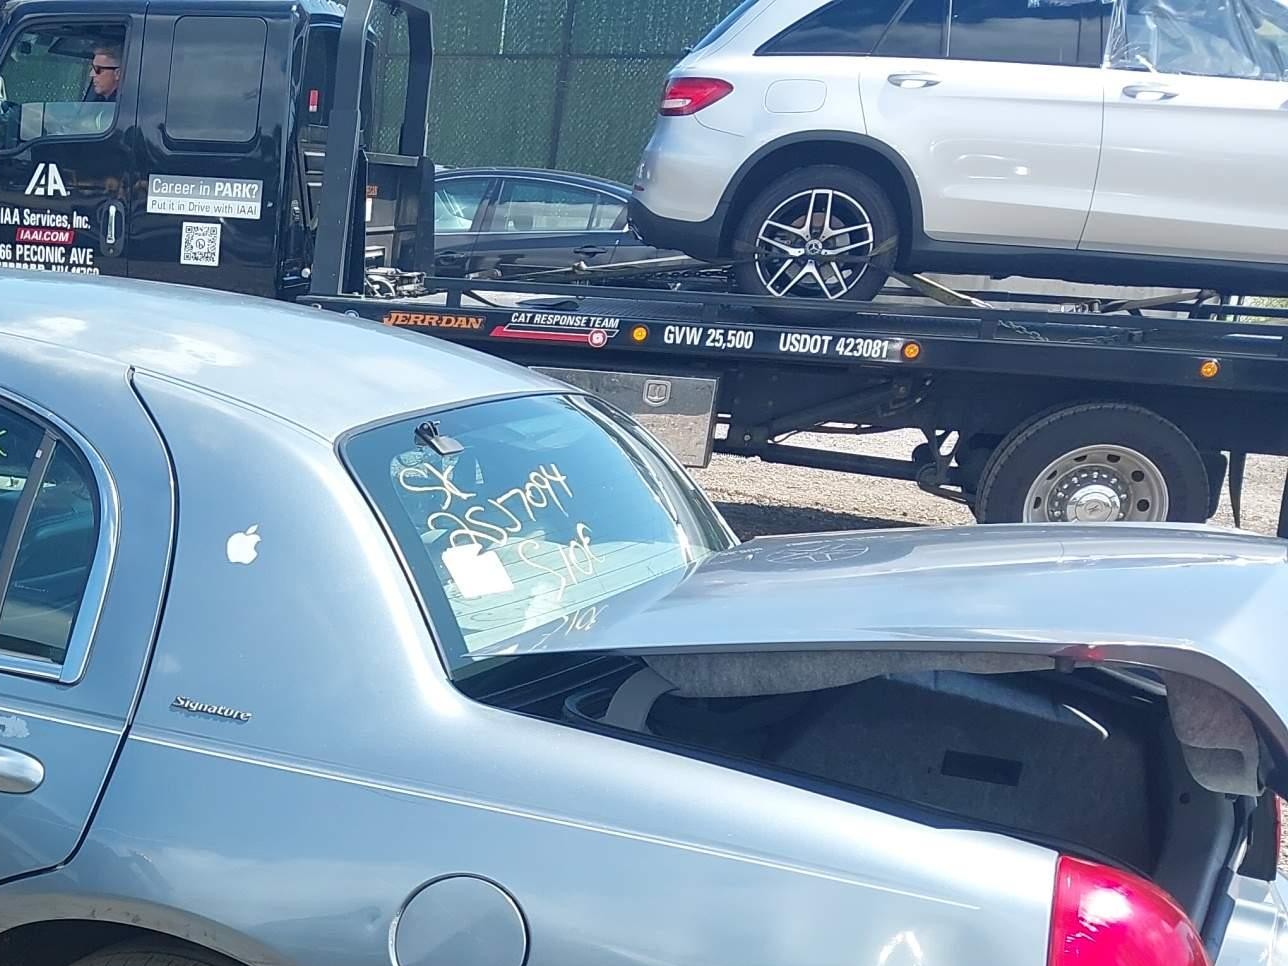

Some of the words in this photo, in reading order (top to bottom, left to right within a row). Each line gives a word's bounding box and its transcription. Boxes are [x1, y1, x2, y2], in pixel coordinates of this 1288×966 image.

[152, 178, 195, 196] Career
[199, 180, 210, 196] in
[214, 181, 259, 199] PARK?
[0, 207, 20, 225] IAA
[23, 208, 71, 229] Services,
[73, 210, 91, 229] Inc.
[151, 199, 166, 210] Put
[169, 200, 174, 210] it
[177, 200, 184, 211] in
[188, 202, 210, 213] Drive
[214, 203, 232, 214] with
[237, 205, 257, 216] IAAI
[20, 229, 70, 242] IAAI.COM
[0, 243, 12, 260] 66
[16, 244, 66, 264] PECONIC
[69, 247, 94, 265] AVE
[511, 312, 534, 323] CAT
[536, 314, 587, 327] RESPONSE
[589, 316, 620, 329] TEAM
[664, 324, 703, 346] GVW
[705, 328, 754, 350] 25,500
[778, 332, 833, 355] USDOT
[835, 336, 890, 359] 423081
[171, 695, 252, 722] Signature
